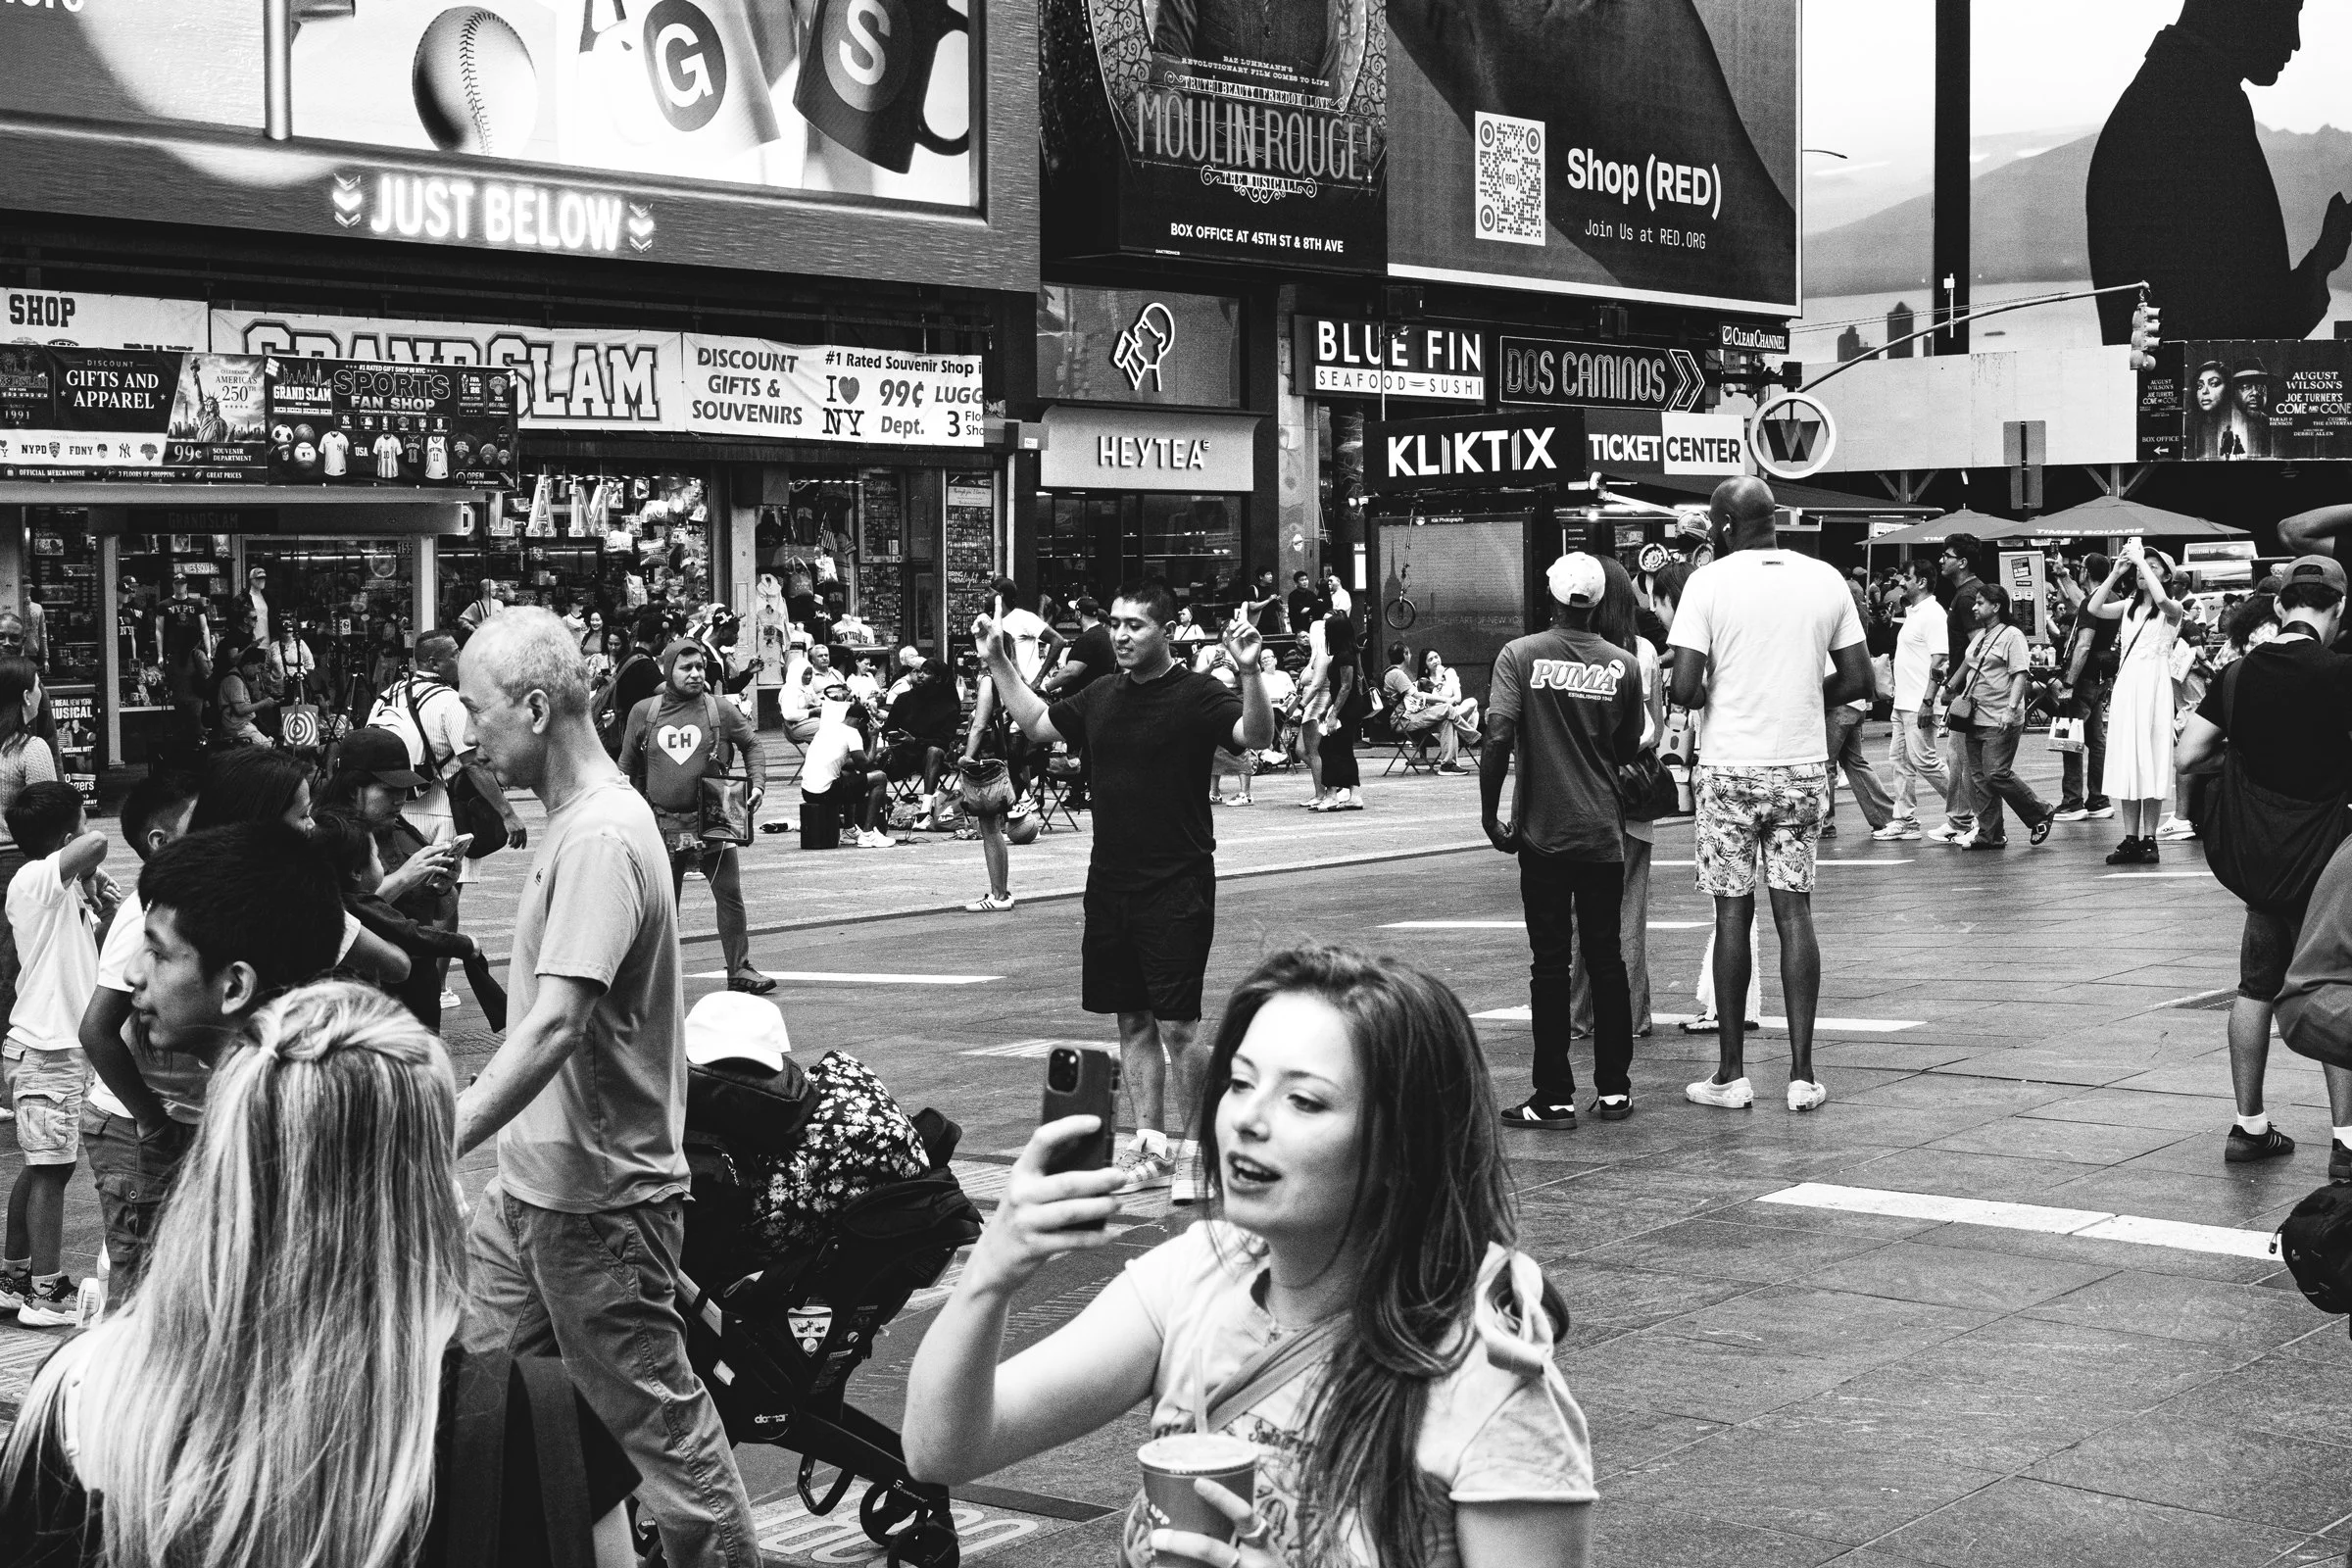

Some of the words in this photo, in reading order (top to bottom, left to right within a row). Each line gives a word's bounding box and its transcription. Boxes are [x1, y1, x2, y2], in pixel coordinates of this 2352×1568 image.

[839, 0, 891, 85] S
[655, 23, 713, 108] G
[1182, 57, 1248, 74] REVOLUTIONARY
[1250, 69, 1270, 77] FILM
[1273, 73, 1298, 82] COMES
[1311, 78, 1330, 87] LIFE
[1241, 59, 1293, 73] LUHRMANN'S
[1183, 75, 1214, 92] TRUTH
[1222, 82, 1255, 98] BEAUTY
[1263, 88, 1302, 106] FREEDOM
[1309, 96, 1332, 109] LOVE
[1138, 92, 1255, 169] MOULIN
[1222, 172, 1243, 186] THE
[1567, 147, 1640, 205] Shop
[1646, 153, 1722, 220] (RED)
[370, 175, 475, 241] JUST
[484, 186, 622, 252] BELOW
[1171, 222, 1194, 238] BOX
[1196, 225, 1233, 242] OFFICE
[1236, 230, 1249, 244] AT
[1251, 231, 1276, 246] 45TH
[1279, 234, 1292, 248] ST
[1294, 236, 1300, 248] &
[1302, 236, 1322, 251] 8TH
[1324, 240, 1344, 253] AVE
[1585, 220, 1613, 238] Join
[1620, 223, 1634, 241] Us
[1640, 227, 1653, 243] at
[1660, 228, 1706, 249] RED.ORG
[9, 293, 76, 328] SHOP
[1318, 320, 1408, 367] BLUE
[1427, 329, 1481, 371] FIN
[697, 347, 799, 373] DISCOUNT
[825, 351, 841, 366] #1
[847, 353, 882, 368] Rated
[886, 356, 938, 372] Souvenir
[941, 360, 974, 378] Shop
[66, 369, 119, 388] GIFTS
[124, 372, 159, 389] AND
[216, 375, 258, 385] AMERICA'S
[334, 369, 450, 400] SPORTS
[708, 374, 760, 397] GIFTS
[766, 378, 781, 398] &
[1319, 370, 1405, 391] SEAFOOD
[1430, 378, 1481, 396] SUSHI
[1506, 348, 1555, 396] DOS
[1562, 351, 1666, 403] CAMINOS
[2286, 381, 2343, 390] WILSON'S
[2292, 371, 2338, 380] AUGUST
[74, 391, 155, 411] APPAREL
[273, 385, 304, 401] GRAND
[306, 387, 331, 402] SLAM
[826, 375, 837, 403] I
[879, 378, 924, 409] 99¢
[2285, 393, 2302, 403] JOE
[2305, 393, 2343, 403] TURNER'S
[5, 411, 30, 419] 1991
[351, 396, 384, 409] FAN
[390, 397, 435, 411] SHOP
[692, 400, 803, 425] SOUVENIRS
[2276, 403, 2307, 414] COME
[2320, 403, 2352, 414] GONE
[822, 408, 864, 436] NY
[881, 416, 925, 439] Dept.
[947, 411, 960, 437] 3
[22, 444, 47, 454] NYPD
[70, 446, 93, 455] FDNY
[355, 447, 368, 457] USA
[1100, 436, 1204, 467] HEYTEA
[1388, 427, 1557, 477] KLIKTIX
[1588, 434, 1661, 462] TICKET
[1666, 436, 1740, 463] CENTER
[1530, 660, 1617, 696] PUMA
[1568, 692, 1600, 701] ESTABLISHED
[667, 733, 691, 749] CH
